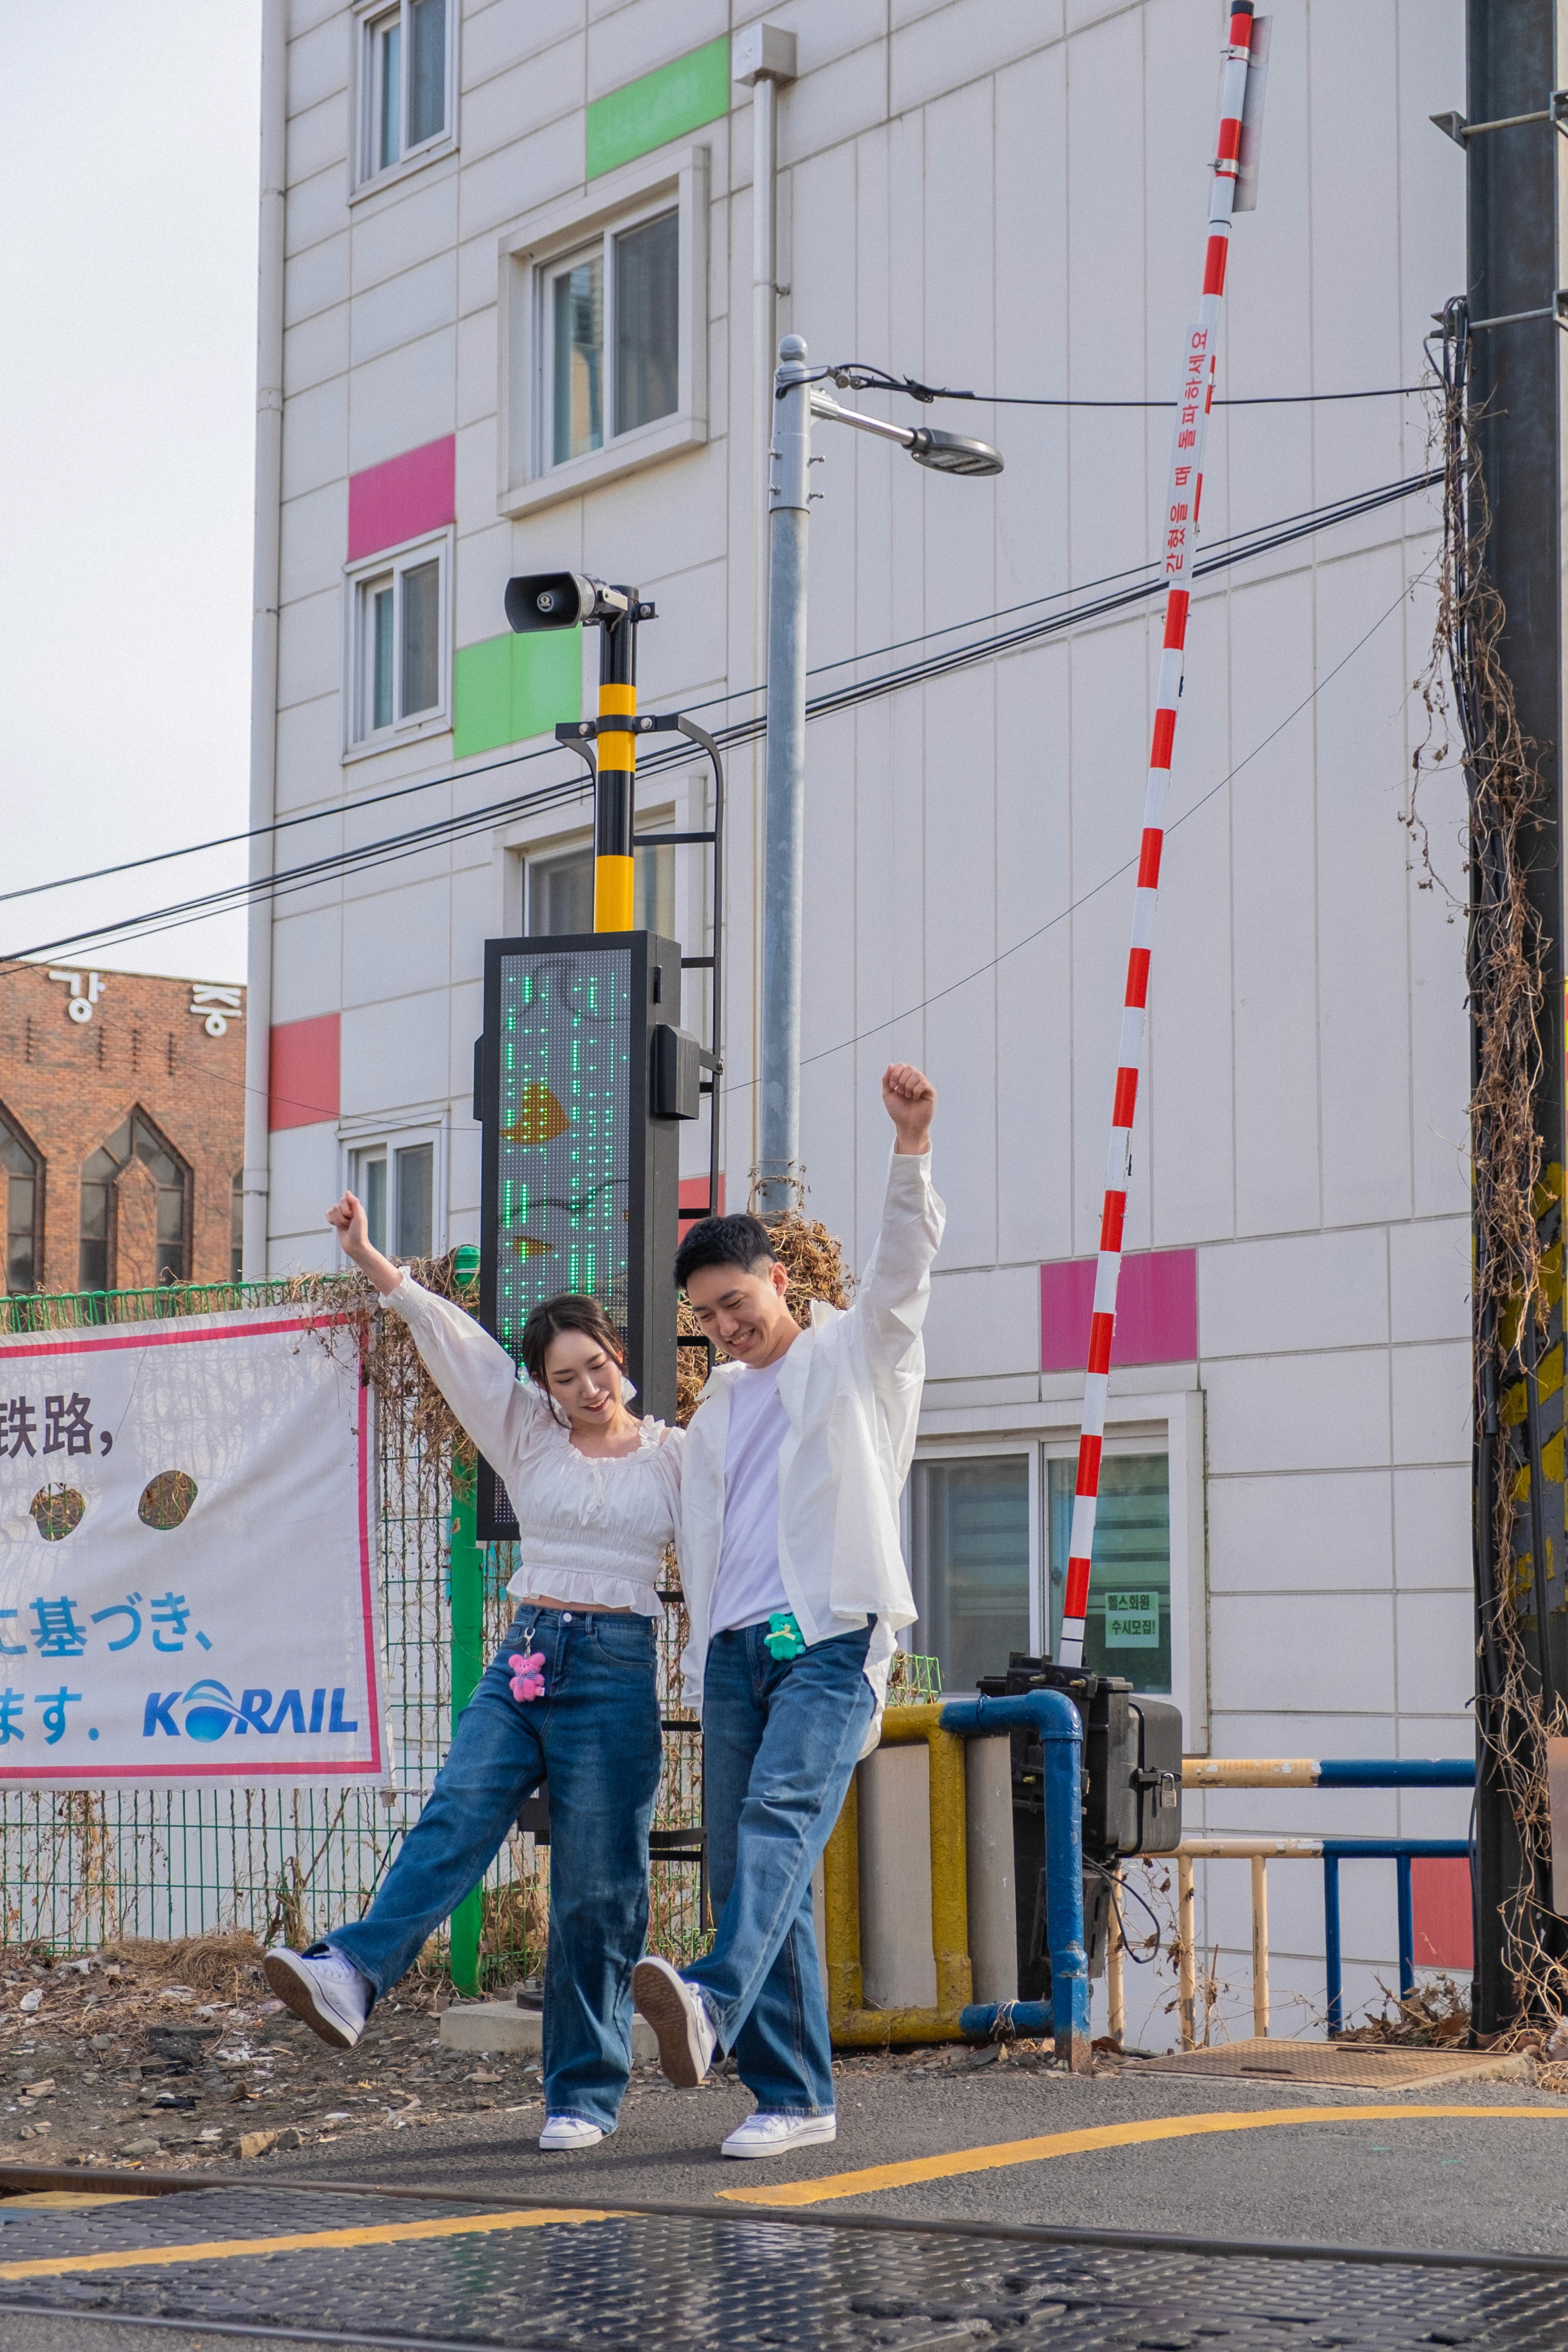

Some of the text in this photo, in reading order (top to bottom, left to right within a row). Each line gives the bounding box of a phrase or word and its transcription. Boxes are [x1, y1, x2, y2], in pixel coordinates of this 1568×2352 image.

[1166, 328, 1208, 573] 갇혔을 때 돌파하세요
[1108, 1594, 1150, 1611] 헬스회원
[1111, 1620, 1155, 1635] 수시모집!
[142, 1679, 358, 1743] KORAIL
